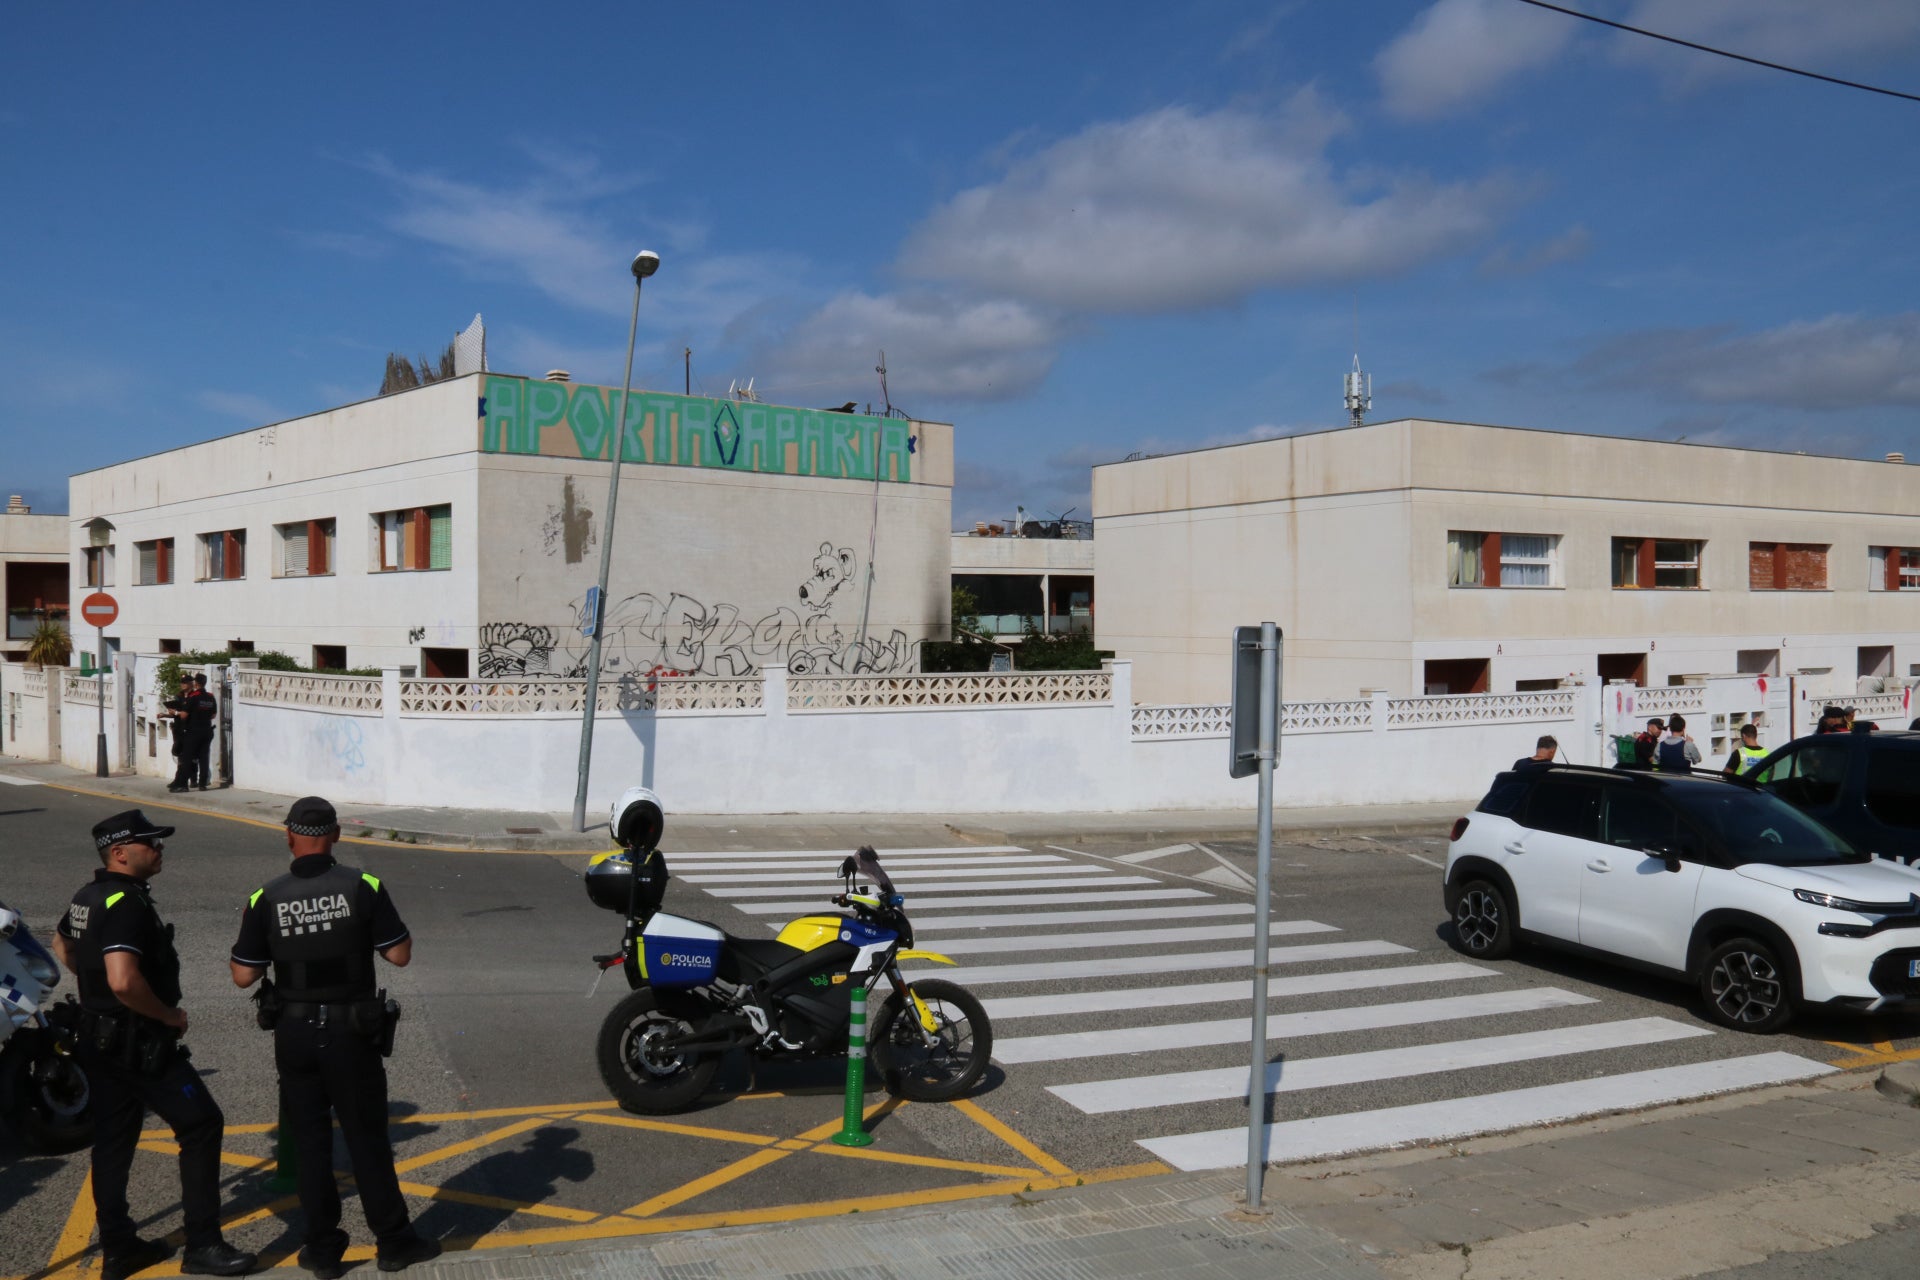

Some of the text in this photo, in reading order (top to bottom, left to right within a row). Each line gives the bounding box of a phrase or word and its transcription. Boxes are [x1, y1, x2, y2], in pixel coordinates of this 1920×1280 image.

[485, 377, 714, 466] APORTA
[741, 406, 910, 482] APARTA
[1496, 643, 1503, 656] A
[276, 893, 349, 918] POLICIA
[279, 906, 351, 927] El Vendrell
[671, 953, 712, 965] POLICIA
